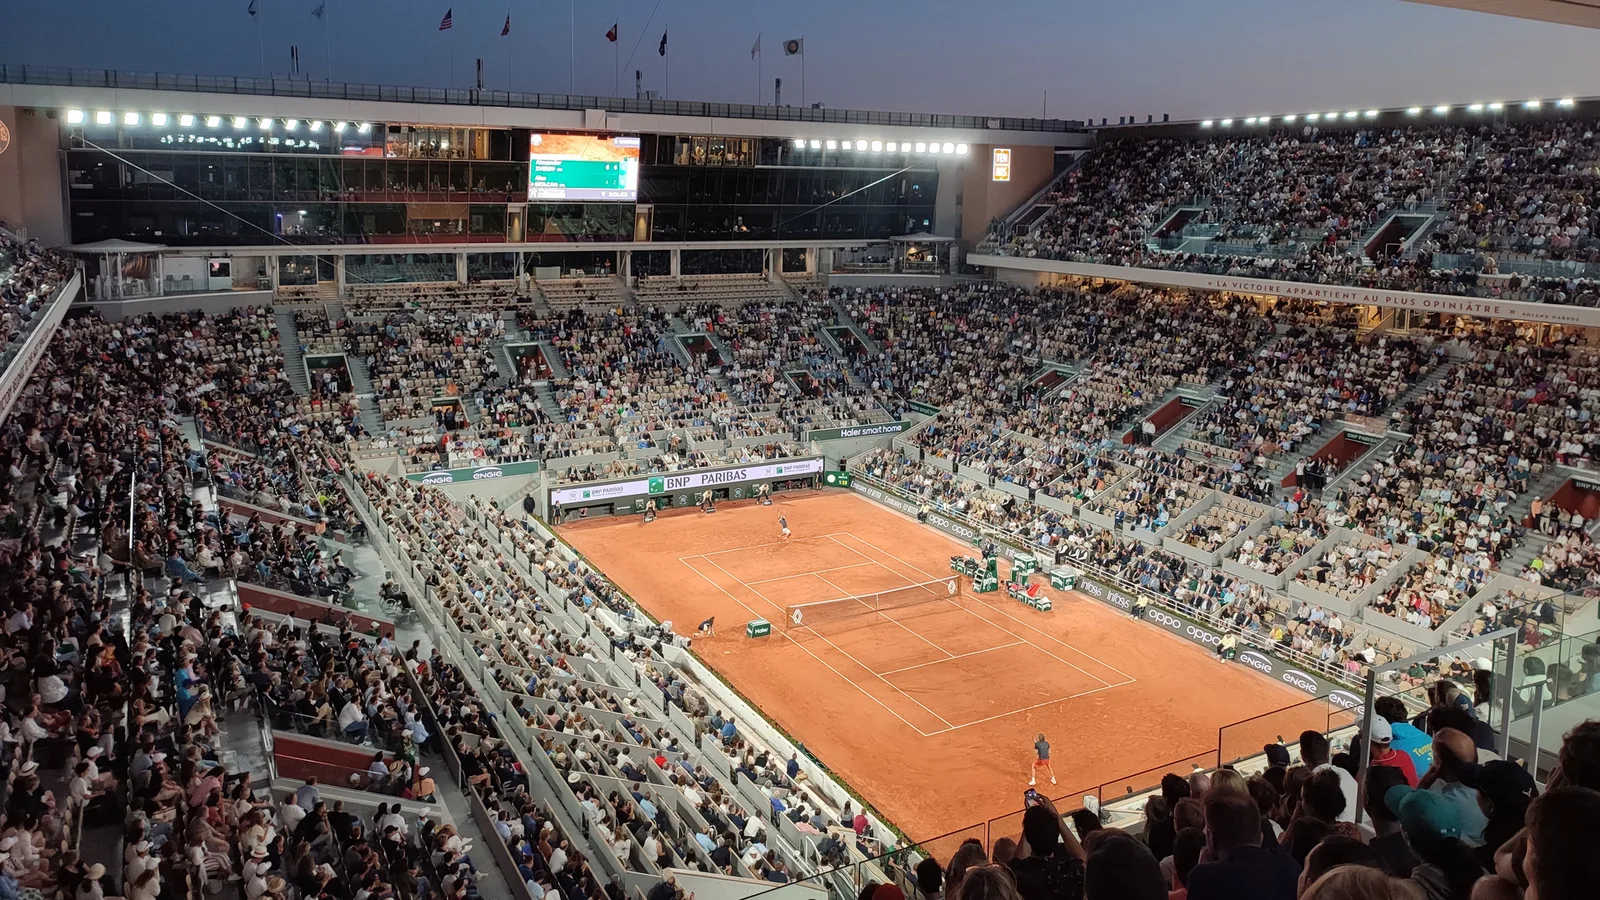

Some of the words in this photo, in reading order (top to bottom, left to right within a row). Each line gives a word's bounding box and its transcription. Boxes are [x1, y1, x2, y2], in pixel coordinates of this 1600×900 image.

[1232, 282, 1281, 293] VICTOIRE
[1286, 287, 1357, 301] APPARTIENT
[1363, 294, 1379, 302] AU
[1385, 296, 1416, 306] PLUS
[1423, 299, 1500, 314] OPINIÂTRE
[841, 429, 861, 438] Haier
[862, 426, 882, 435] smart
[882, 425, 902, 433] home
[667, 476, 690, 489] BNP
[701, 469, 747, 484] PARIBAS
[929, 514, 950, 528] oppo
[952, 524, 973, 538] oppo
[1081, 579, 1103, 597] Infosys
[1107, 590, 1131, 609] Infosys
[1149, 609, 1181, 629] oppo
[1187, 625, 1221, 646] oppo
